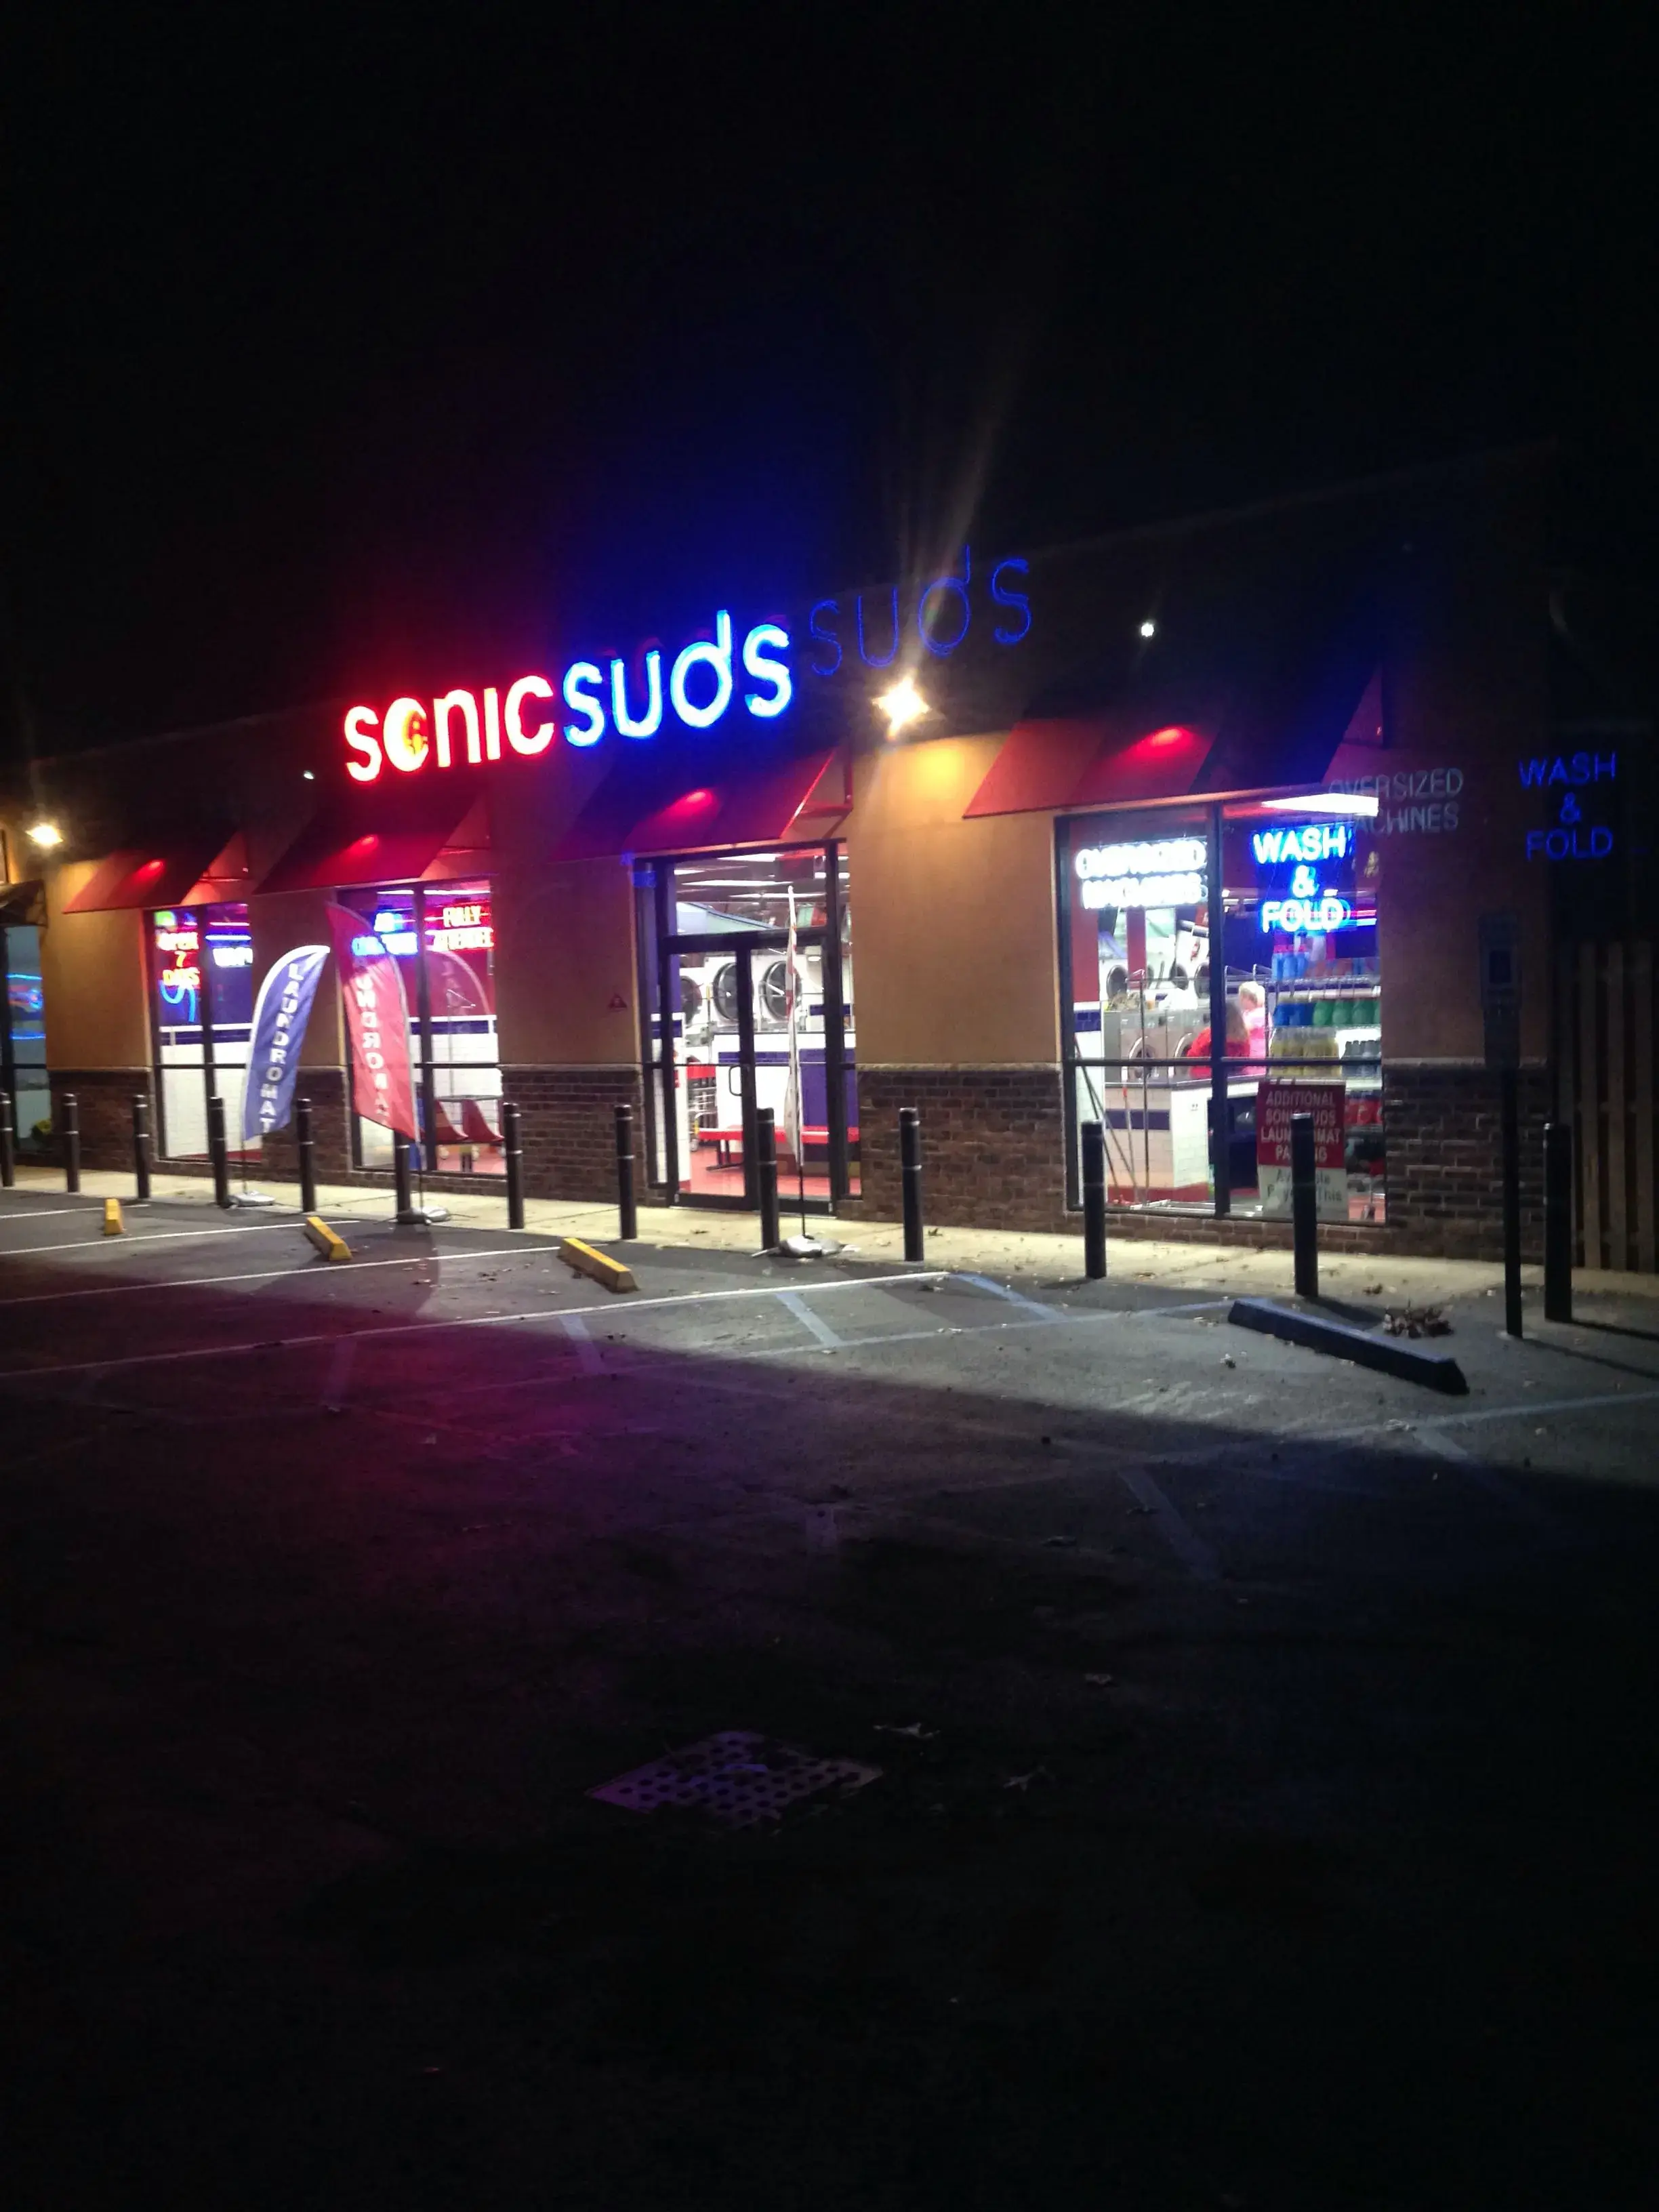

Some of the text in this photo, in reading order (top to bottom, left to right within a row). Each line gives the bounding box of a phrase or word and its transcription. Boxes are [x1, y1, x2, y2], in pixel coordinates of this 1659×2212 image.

[1518, 750, 1618, 789] WASH
[1338, 801, 1460, 838] ACHINES
[1559, 792, 1582, 824] &
[1253, 825, 1347, 865] WASH
[1525, 826, 1614, 861] FOLD
[1292, 864, 1319, 899] &
[1261, 896, 1349, 934] FOLD
[174, 950, 187, 968] 7
[259, 962, 304, 1133] LAUNDROMAT
[1265, 1089, 1335, 1106] ADDITIONAL
[1261, 1125, 1341, 1145] LAUNMAT
[1265, 1108, 1336, 1128] SONI UDS
